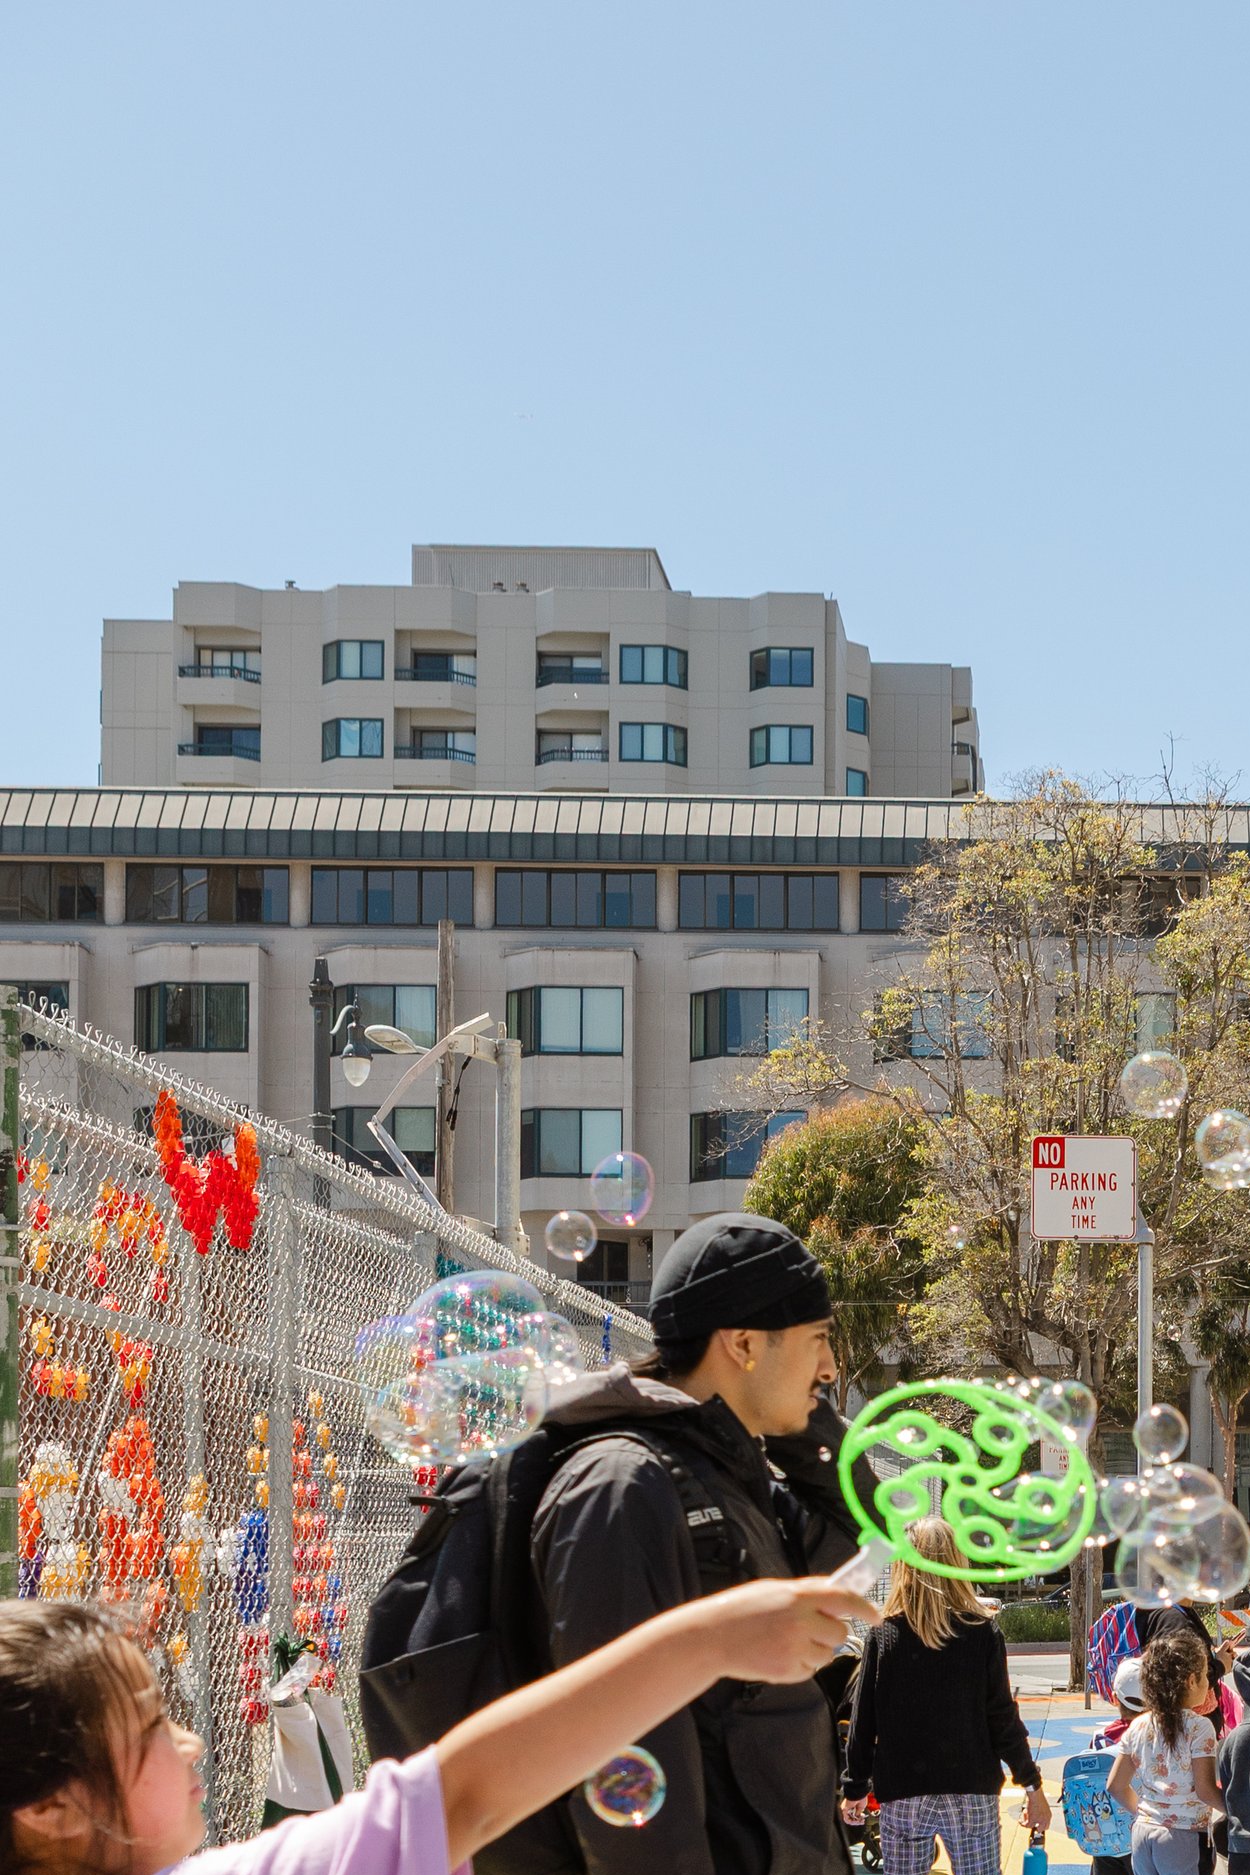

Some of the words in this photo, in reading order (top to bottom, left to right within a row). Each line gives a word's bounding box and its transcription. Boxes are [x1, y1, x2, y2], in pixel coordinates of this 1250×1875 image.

[1038, 1142, 1061, 1165] NO
[1050, 1172, 1117, 1191] PARKING
[1072, 1196, 1096, 1210] ANY
[1071, 1215, 1096, 1229] TIME
